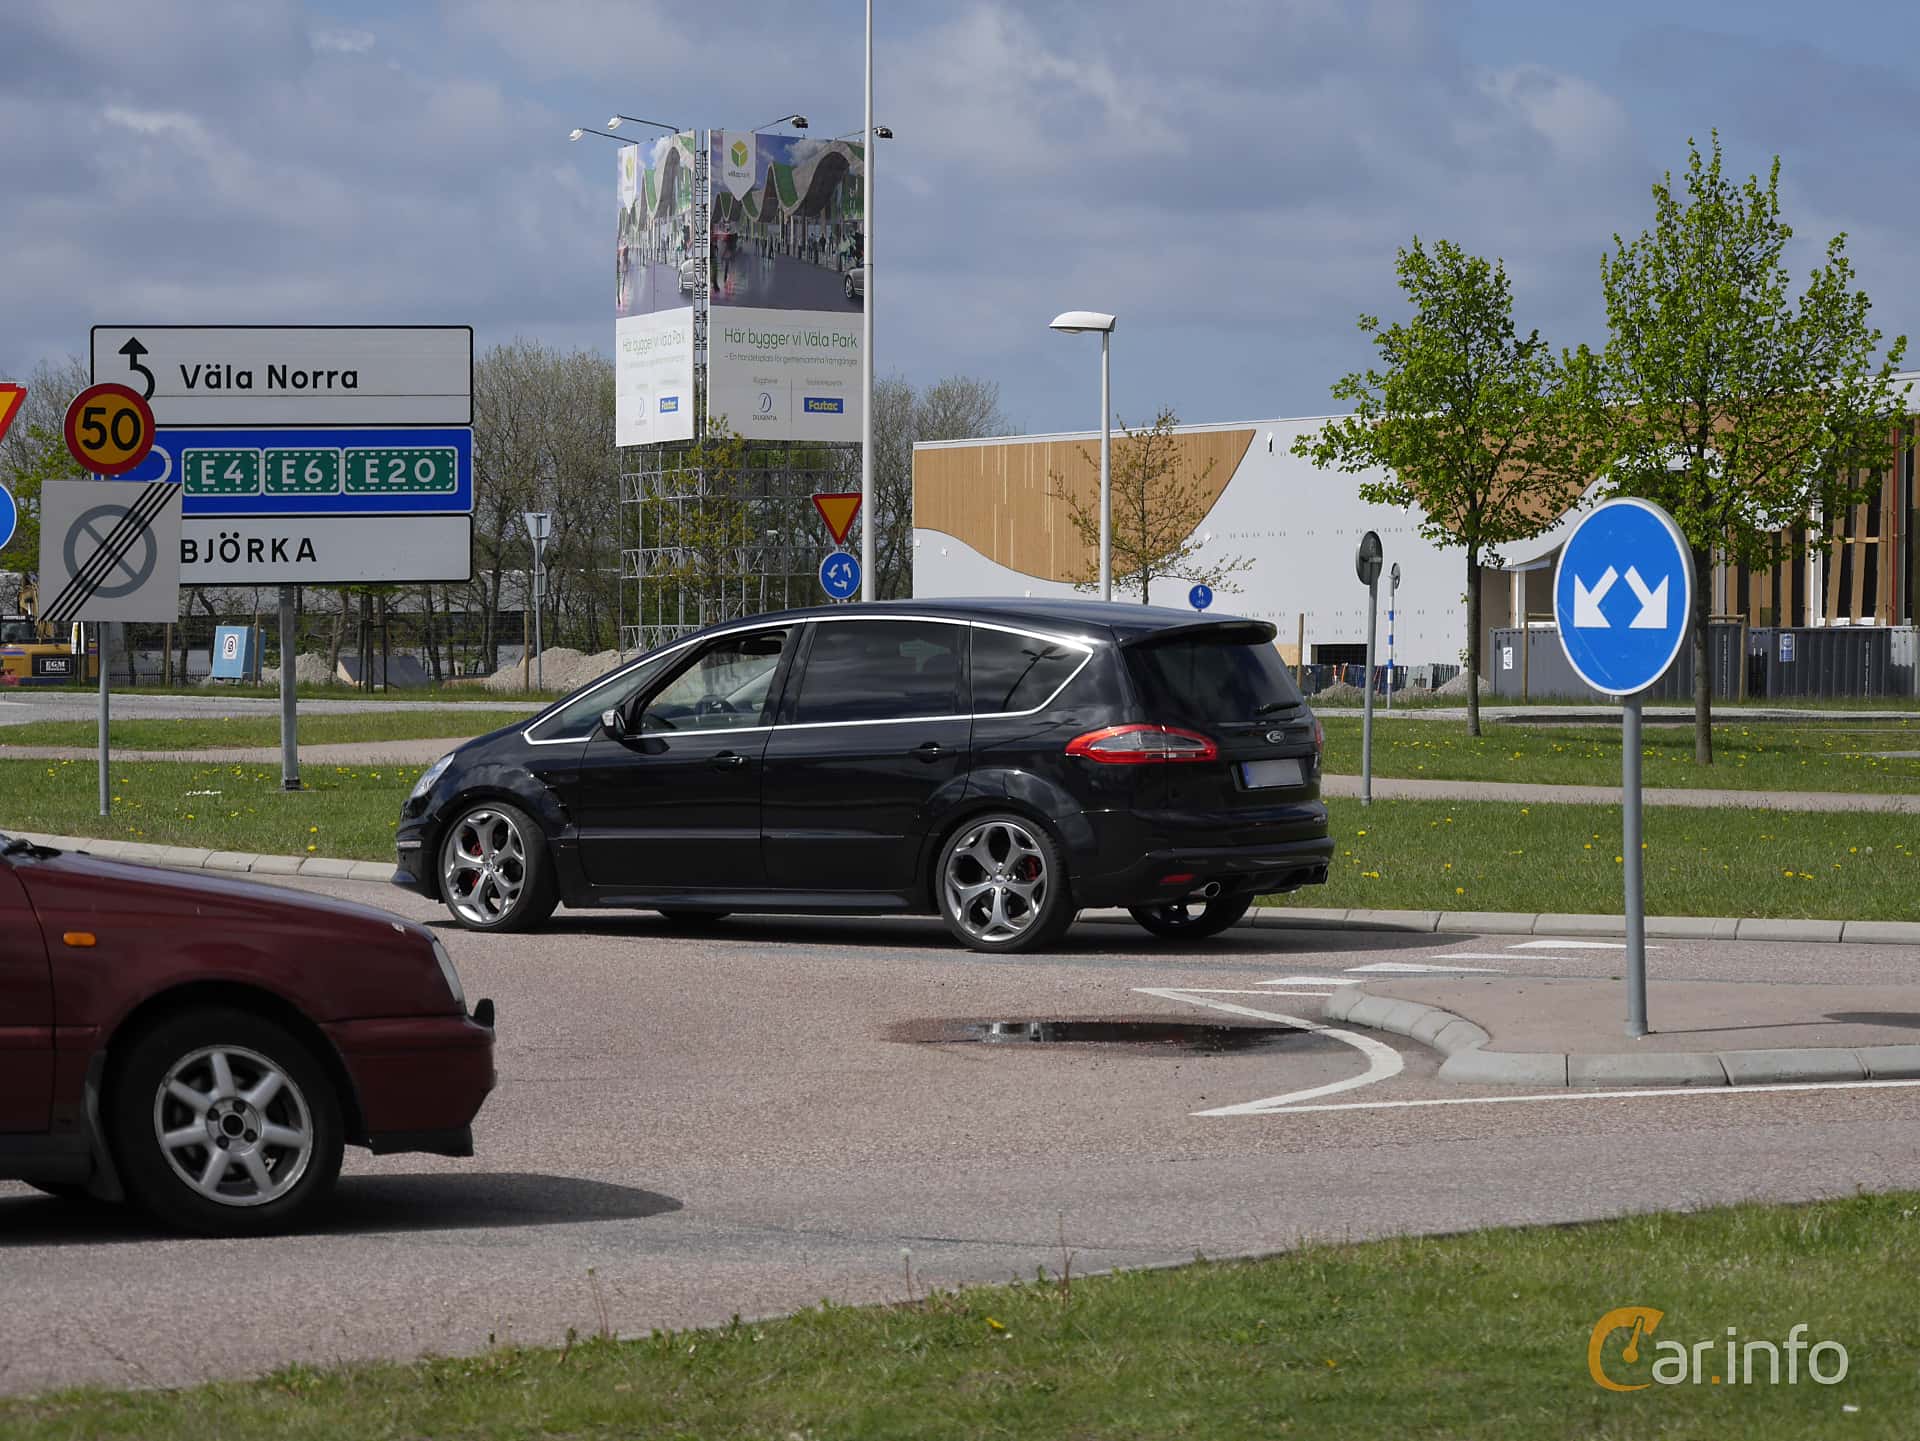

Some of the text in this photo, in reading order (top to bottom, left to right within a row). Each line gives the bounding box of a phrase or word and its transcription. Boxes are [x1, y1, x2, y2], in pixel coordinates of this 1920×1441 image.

[724, 327, 857, 349] Här bygger vi Väla Park
[180, 364, 359, 389] Väla Norra
[82, 406, 141, 451] 50
[200, 457, 436, 484] E4 E6 E20
[180, 531, 317, 563] BJÖRKA
